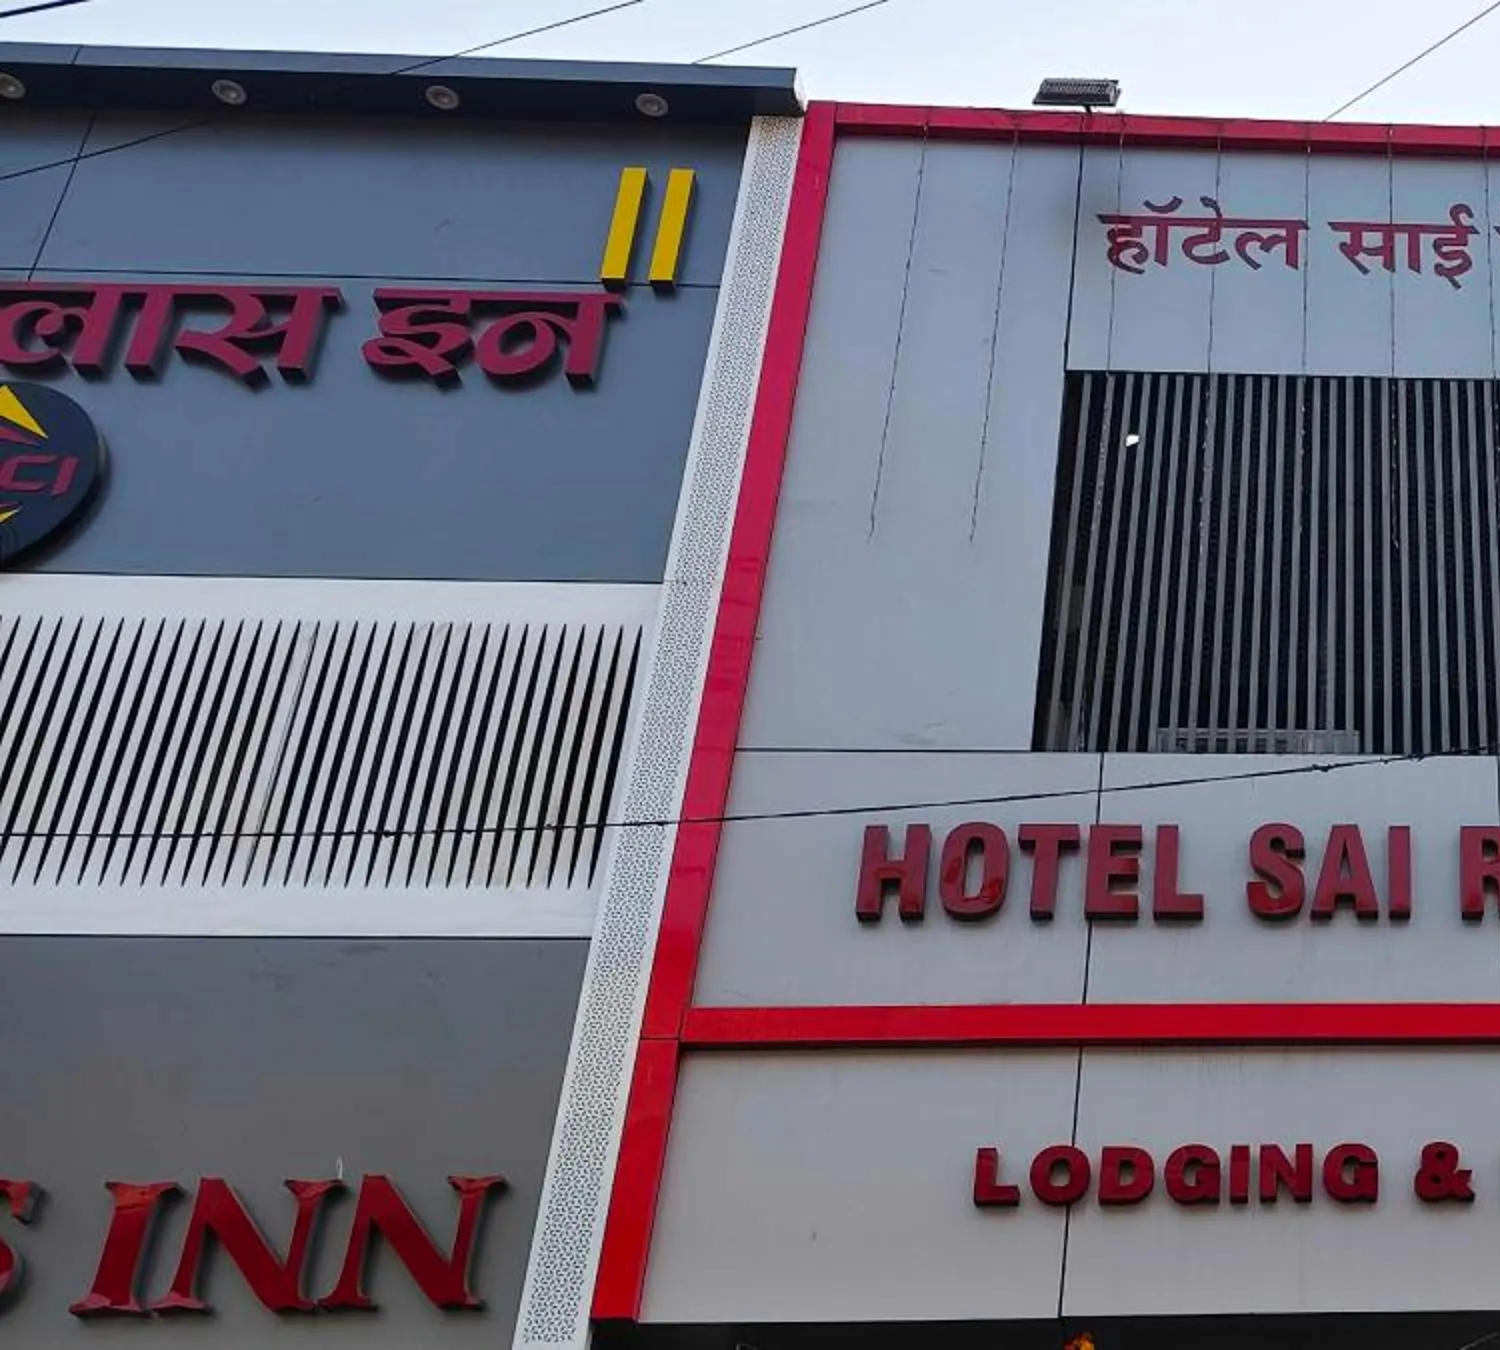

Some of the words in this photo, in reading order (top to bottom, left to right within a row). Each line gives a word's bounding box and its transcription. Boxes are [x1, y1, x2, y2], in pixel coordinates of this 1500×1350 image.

[1096, 196, 1310, 274] हॉटेल
[1327, 203, 1479, 290] साई
[361, 288, 624, 387] इन
[855, 821, 1204, 922] HOTEL
[1246, 821, 1412, 922] SAI
[972, 1142, 1379, 1207] LODGING
[1414, 1141, 1475, 1203] &
[68, 1173, 510, 1317] INN
